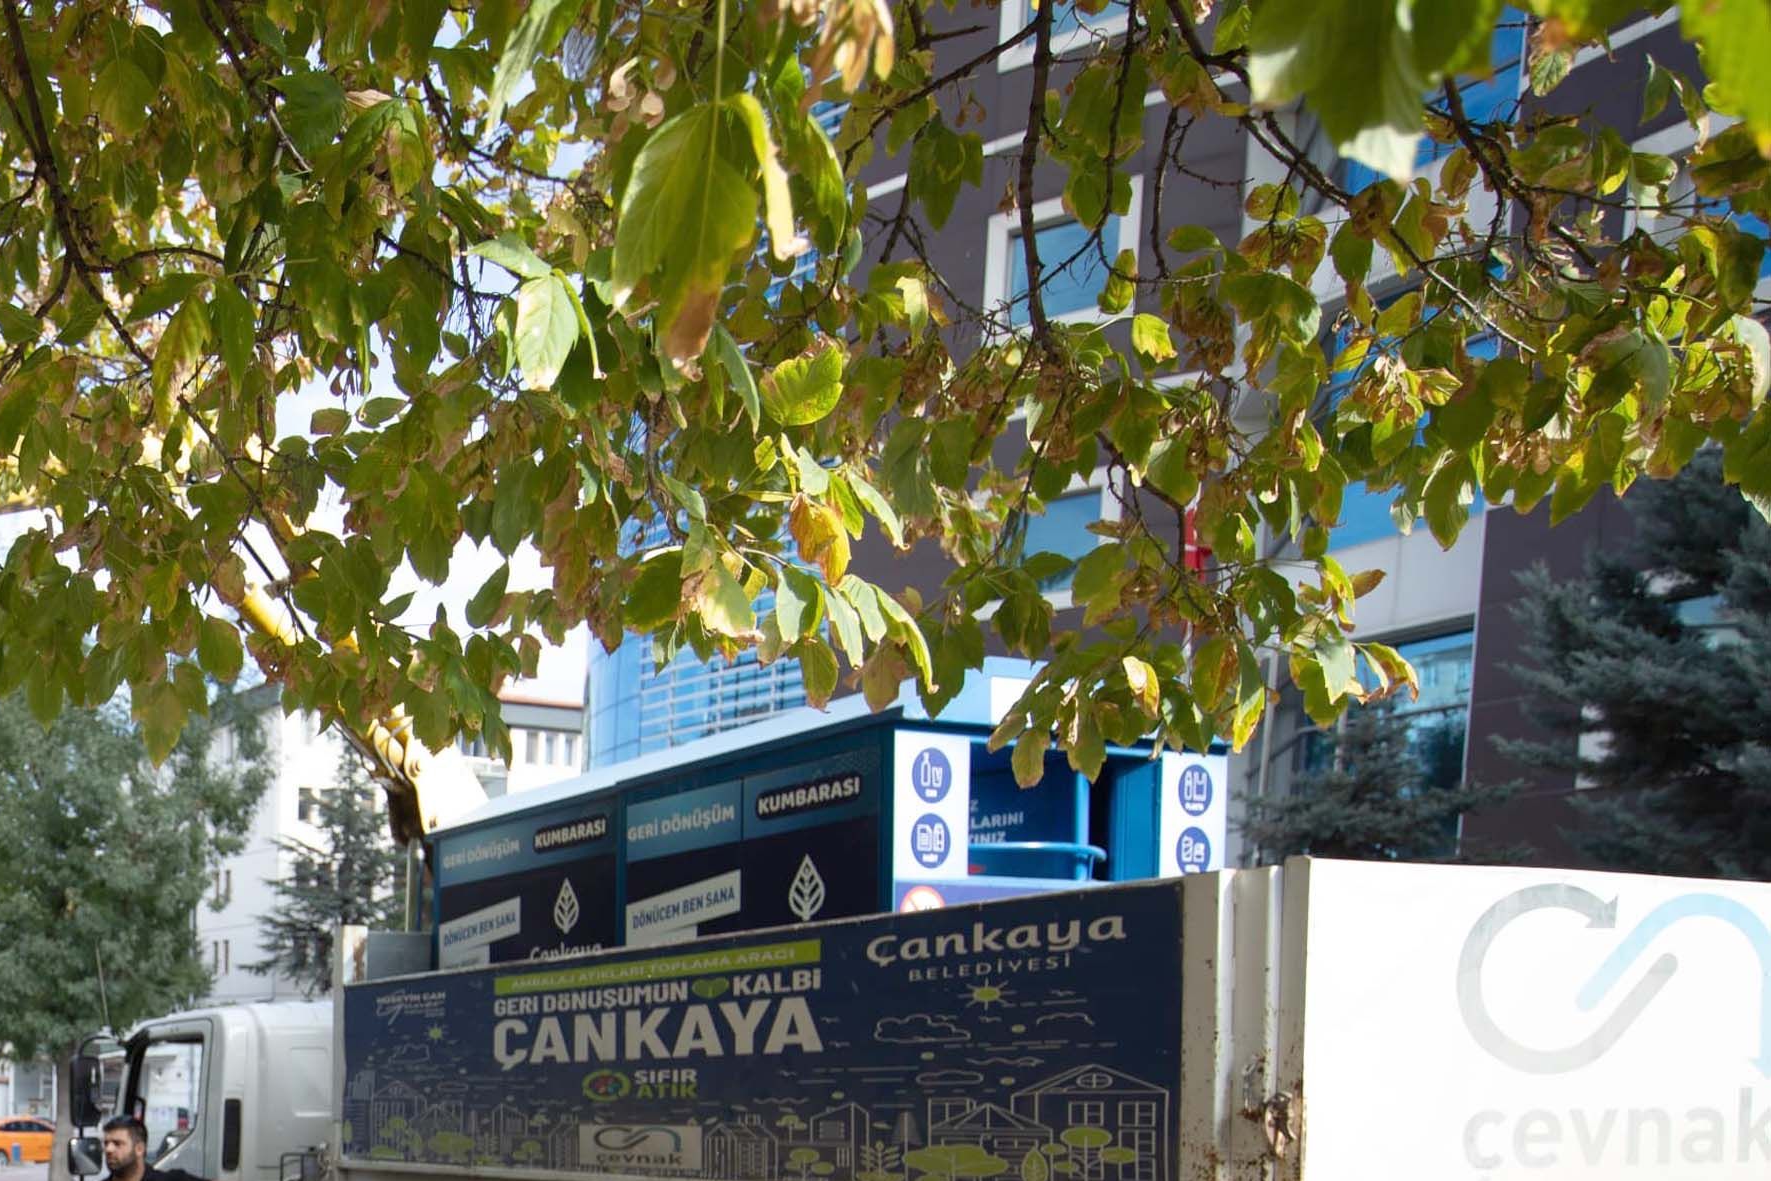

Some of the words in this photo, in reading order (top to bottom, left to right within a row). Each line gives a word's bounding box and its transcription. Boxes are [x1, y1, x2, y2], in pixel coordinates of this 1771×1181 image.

[627, 817, 658, 841] GERİ
[661, 804, 735, 834] DÖNÜŞÜM
[758, 777, 860, 815] KUMBARASI
[970, 811, 1024, 829] LARINI
[534, 818, 606, 848] KUMBARASI
[496, 911, 517, 930] SANA
[632, 905, 679, 929] DÖNÜCEM
[682, 896, 704, 914] BEN
[706, 886, 735, 908] SANA
[866, 915, 1127, 967] Çankaya
[733, 968, 822, 996] KALBİ
[908, 952, 1071, 982] BELEDİYESİ
[493, 997, 824, 1071] ÇANKAYA
[634, 1069, 697, 1084] SIFIR
[636, 1083, 698, 1098] ATIK
